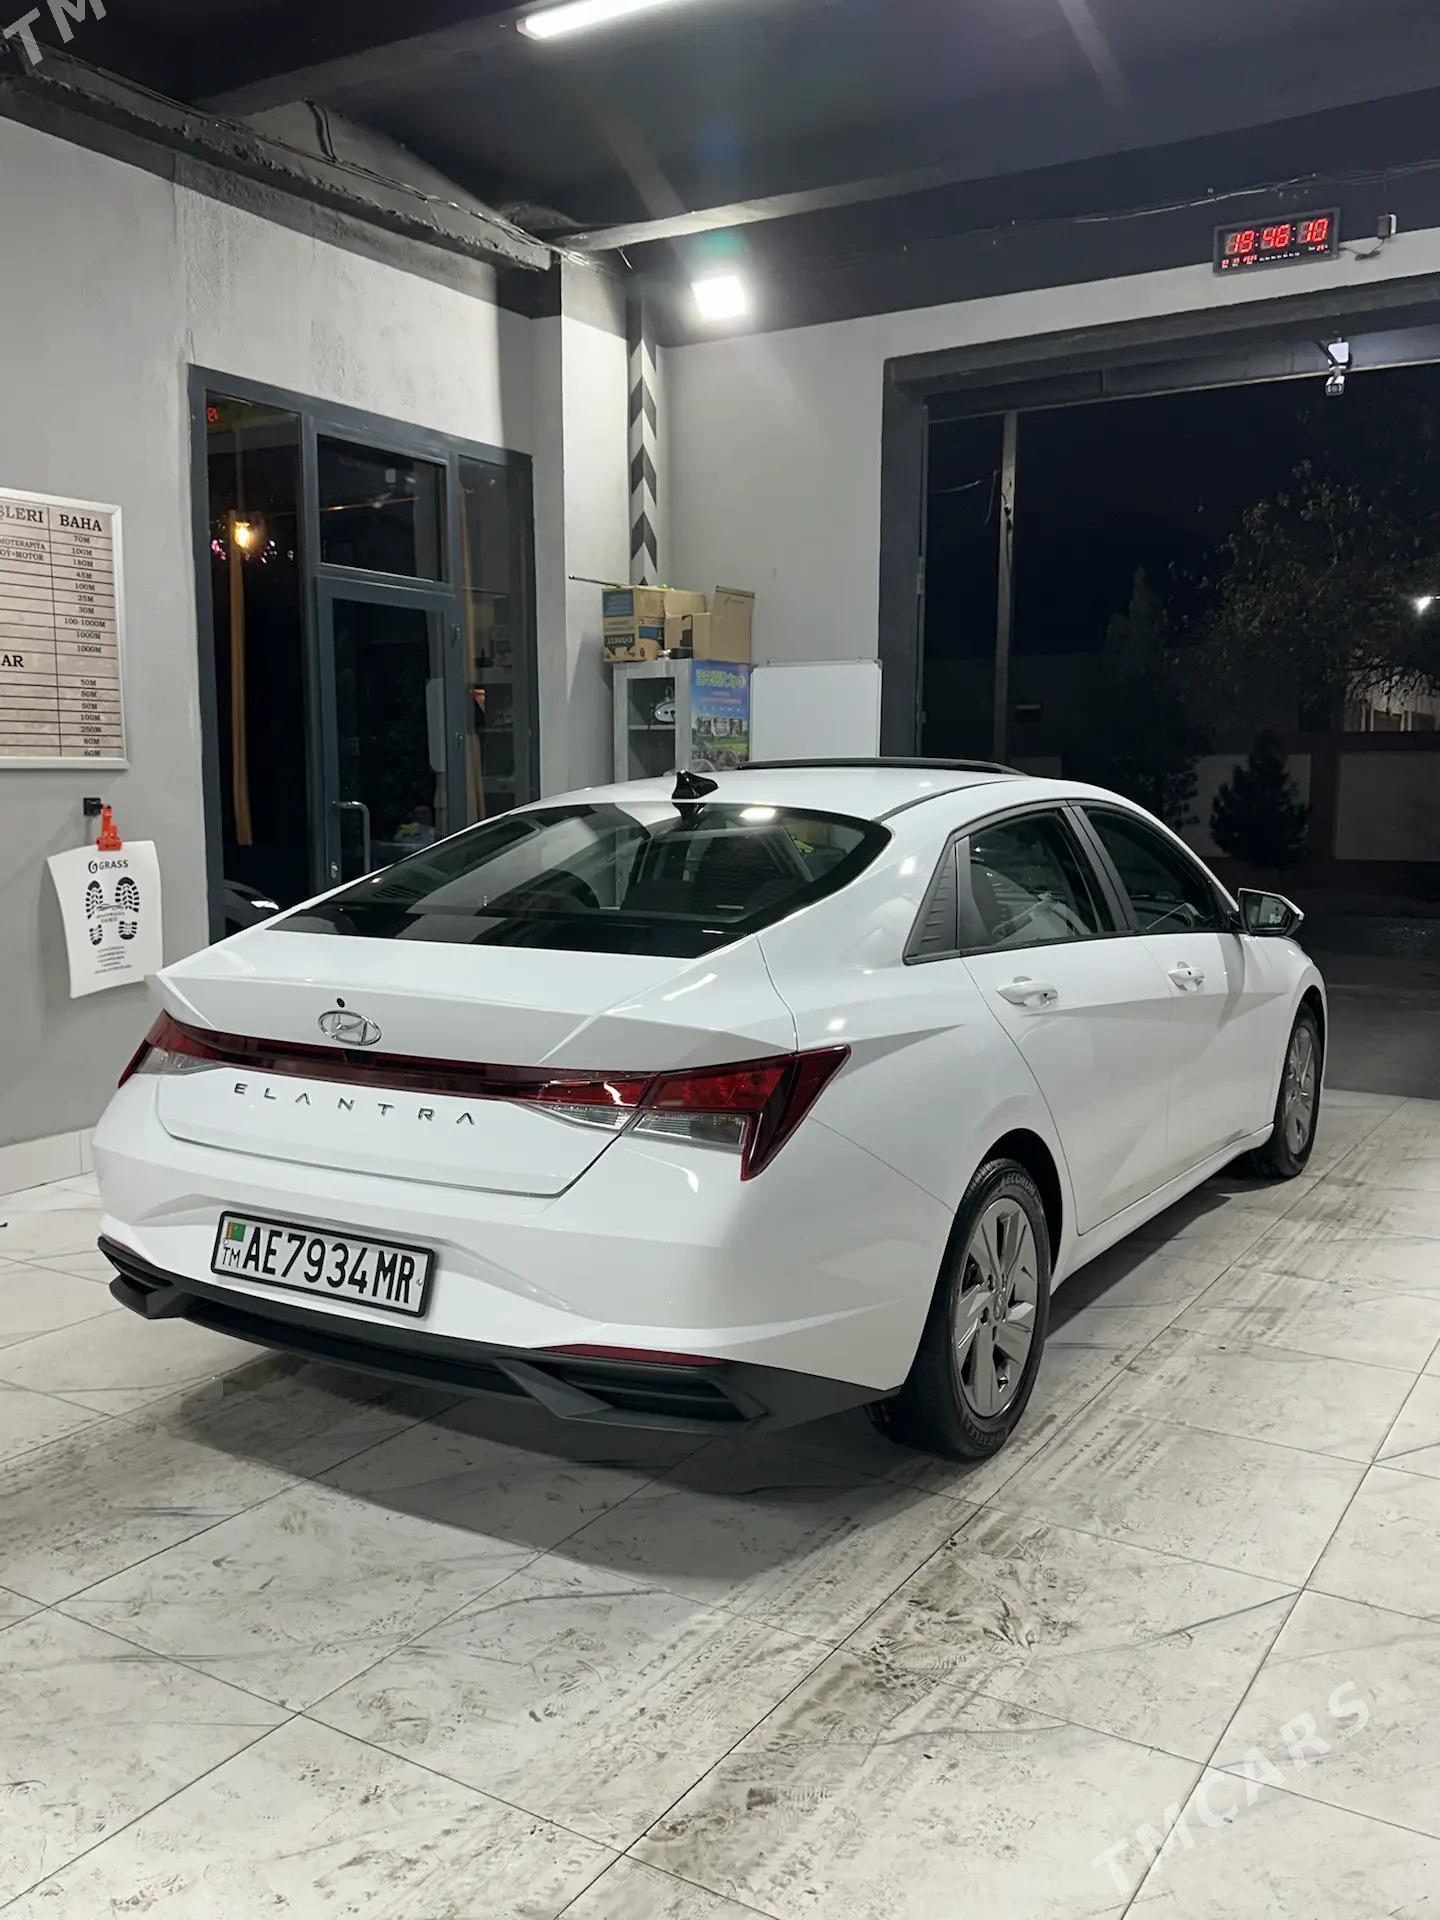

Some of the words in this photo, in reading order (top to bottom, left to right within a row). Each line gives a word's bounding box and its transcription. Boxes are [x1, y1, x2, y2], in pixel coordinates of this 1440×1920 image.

[59, 514, 102, 532] BAHA
[73, 535, 91, 544] 70M
[72, 547, 93, 556] 100M
[74, 582, 95, 591] 100M
[76, 631, 101, 640] 1000M
[77, 645, 102, 653] 1000M
[99, 859, 129, 870] GRASS
[233, 1082, 475, 1126] ELANTRA
[222, 1246, 241, 1268] TM
[242, 1226, 415, 1304] AE7934MR
